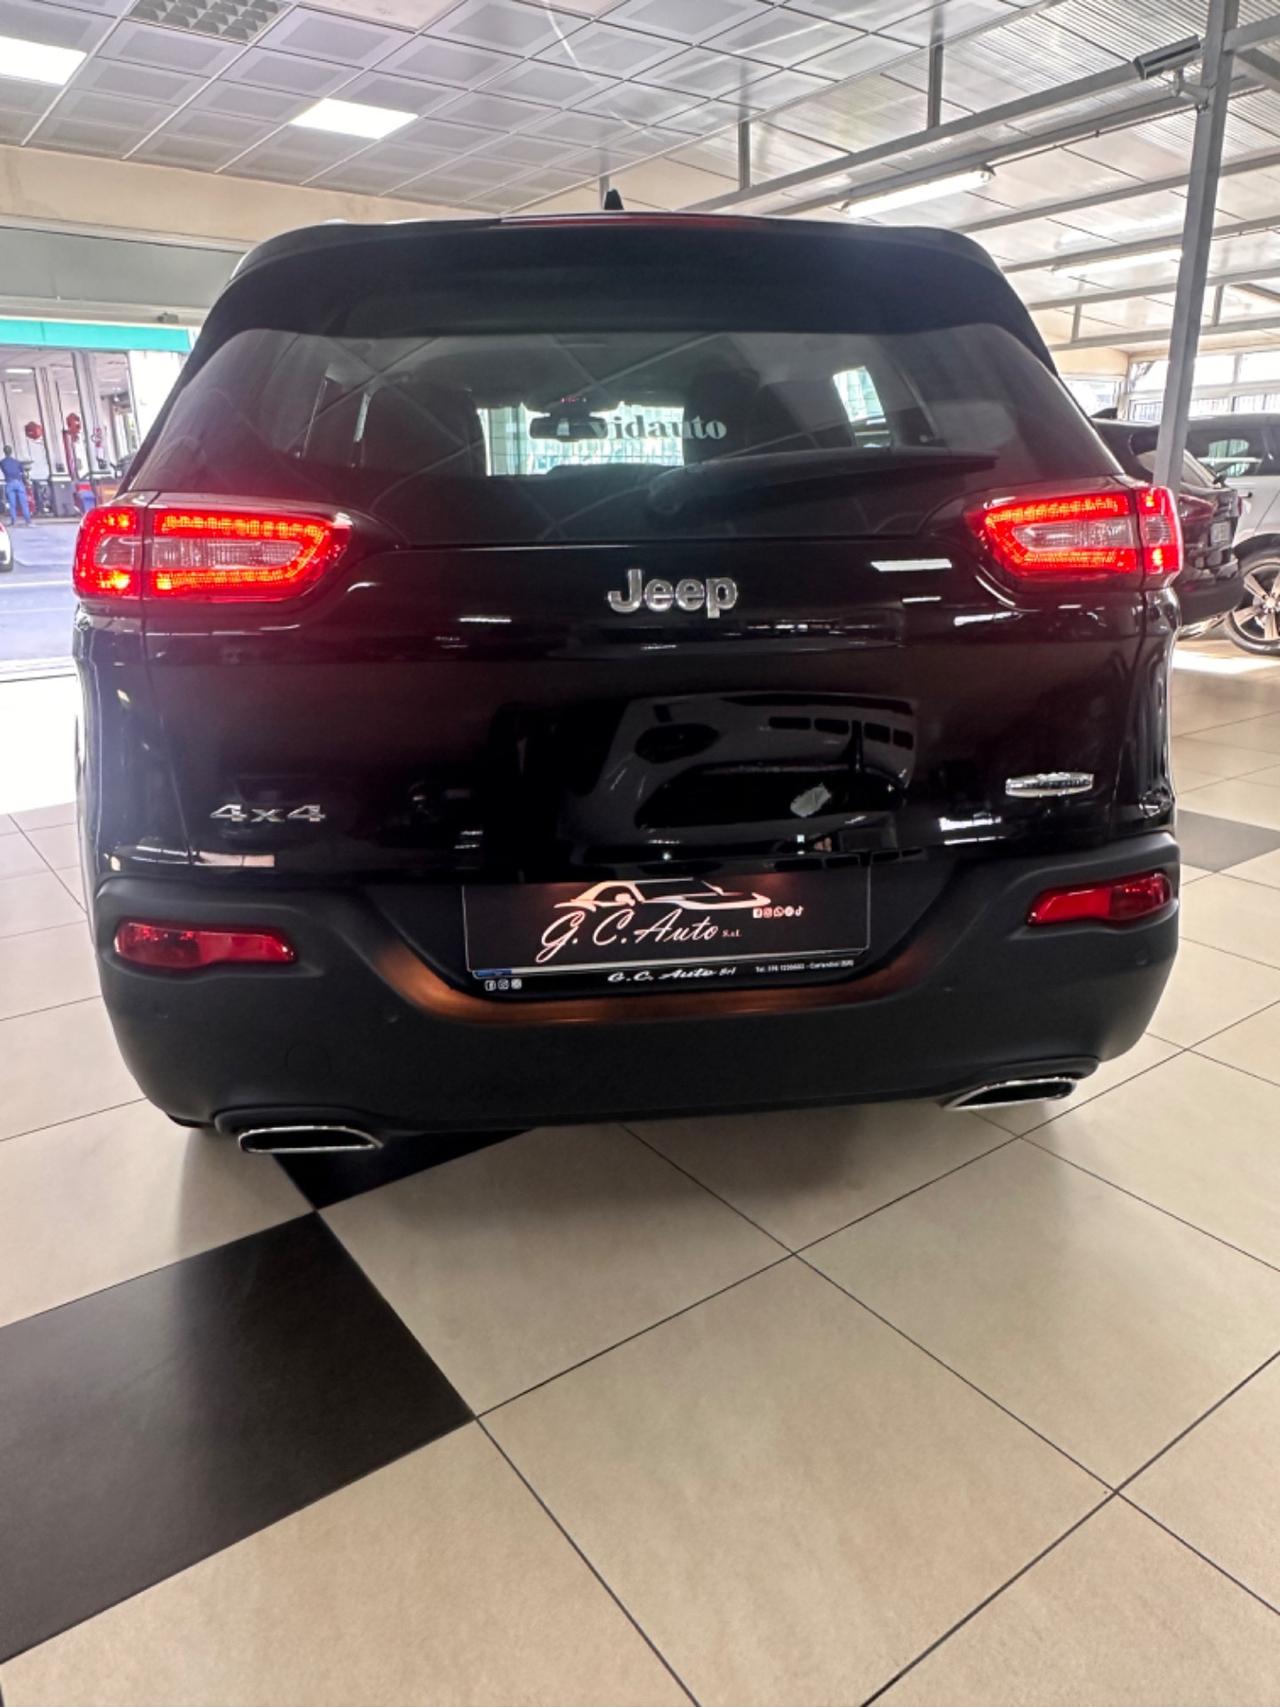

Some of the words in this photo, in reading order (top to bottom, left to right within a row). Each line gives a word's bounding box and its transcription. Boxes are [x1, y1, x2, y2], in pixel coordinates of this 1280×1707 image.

[607, 568, 738, 618] Jeep
[210, 803, 326, 822] 4x4
[633, 908, 719, 944] Auto
